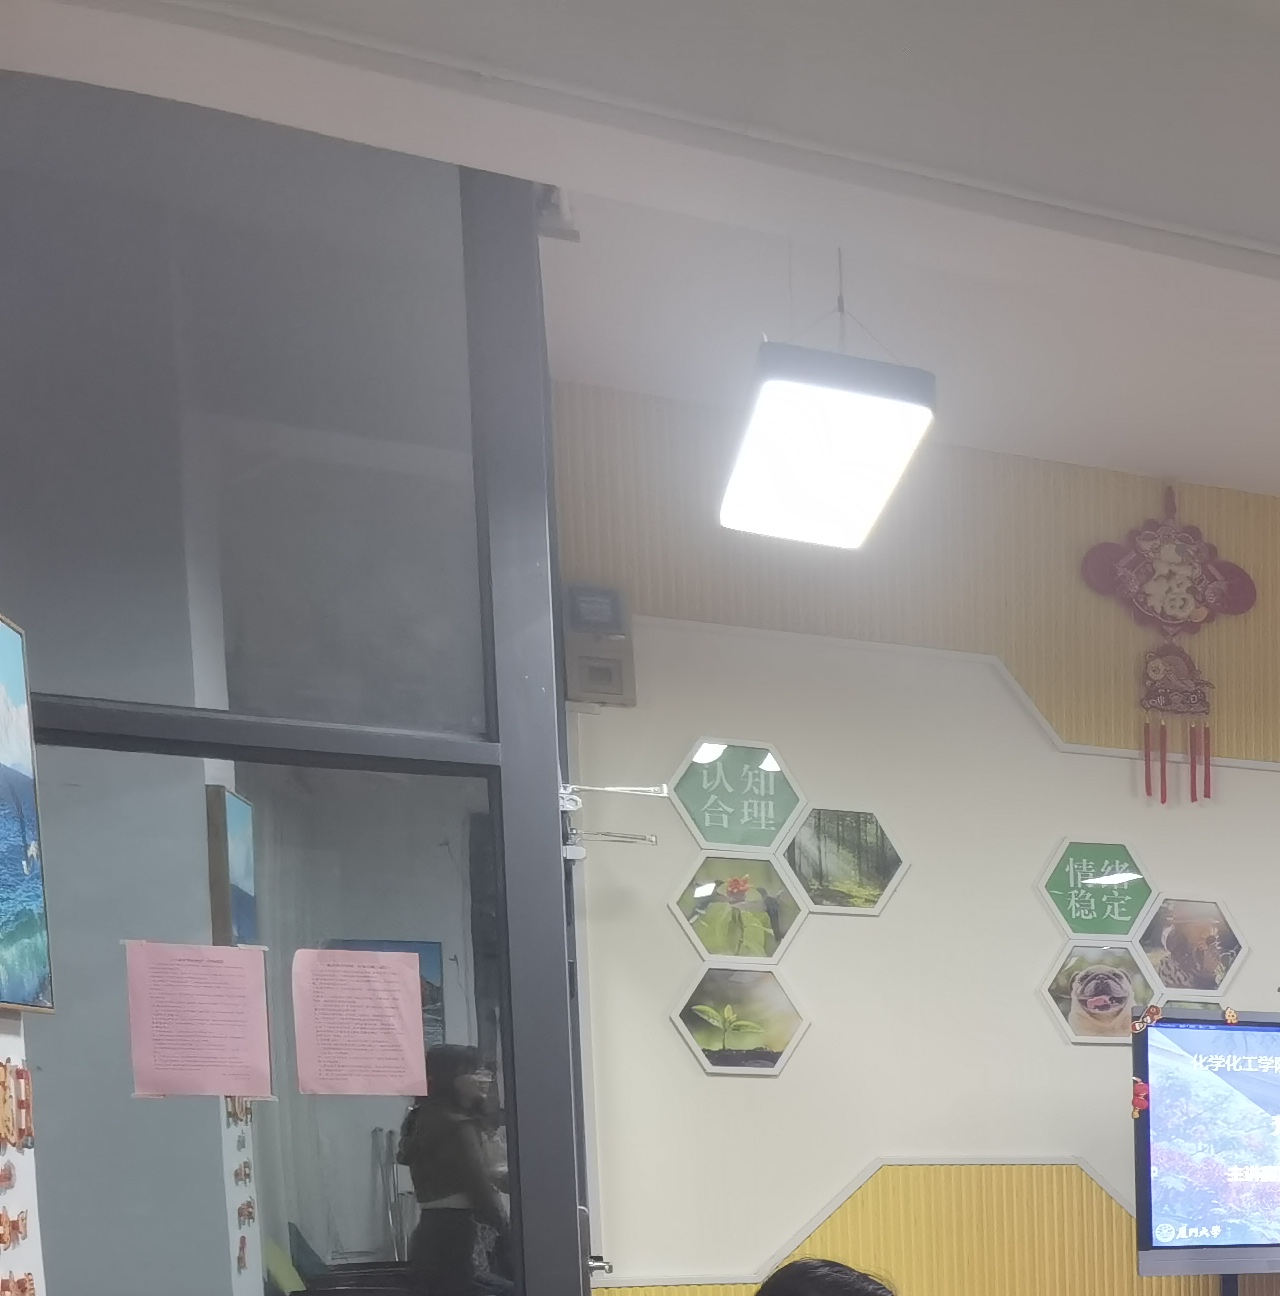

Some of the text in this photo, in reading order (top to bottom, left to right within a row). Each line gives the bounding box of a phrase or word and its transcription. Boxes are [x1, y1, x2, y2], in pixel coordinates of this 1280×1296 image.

[700, 761, 776, 796] 认知
[701, 795, 776, 831] 合理
[1065, 857, 1132, 891] 情绪
[1066, 889, 1132, 924] 稳定
